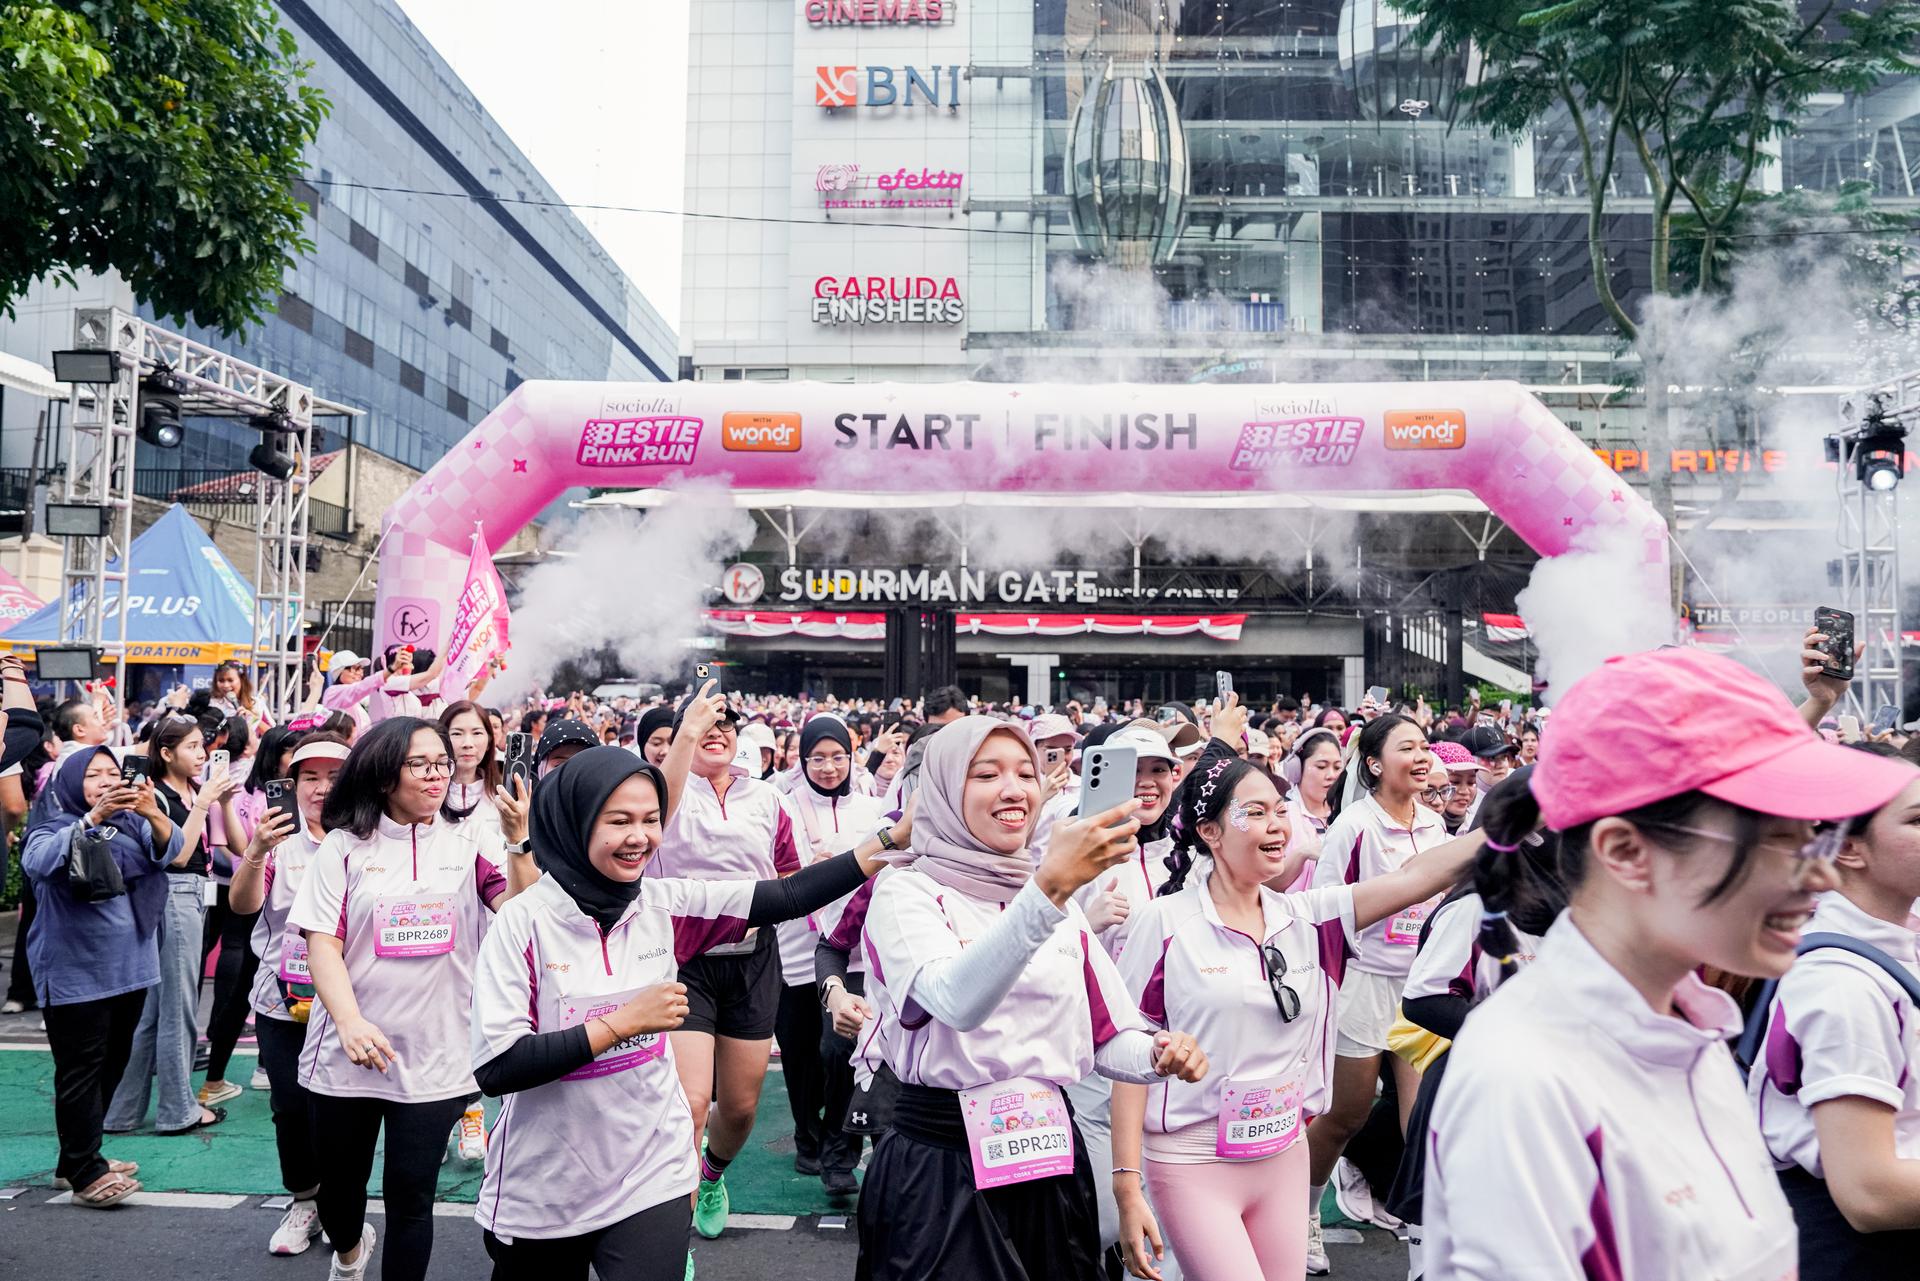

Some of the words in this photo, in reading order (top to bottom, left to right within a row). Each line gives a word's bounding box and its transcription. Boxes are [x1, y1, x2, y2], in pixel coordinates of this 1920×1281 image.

[804, 0, 944, 23] CINEMAS
[865, 65, 961, 107] BNI
[877, 168, 963, 191] efekta
[814, 275, 962, 302] GARUDA
[811, 296, 964, 325] FINISHERS
[605, 397, 674, 414] sociolla
[1260, 399, 1333, 416] sociolla
[596, 419, 700, 446] BESTIE
[729, 423, 796, 441] wondr
[833, 412, 982, 450] START
[1033, 412, 1199, 451] FINISH
[1251, 420, 1361, 449] BESTIE
[1391, 419, 1459, 440] wondr
[580, 445, 638, 463] PINK
[641, 444, 695, 463] RUN
[1233, 449, 1295, 468] PINK
[1298, 445, 1355, 466] RUN
[779, 568, 986, 602] SUDIRMAN
[998, 570, 1098, 603] GATE
[1695, 608, 1731, 623] THE
[125, 646, 201, 658] YDRATION
[397, 928, 449, 942] BPR2689
[545, 962, 571, 973] wodr
[1247, 1113, 1296, 1139] BPR2332
[1007, 1133, 1068, 1156] BPR2378
